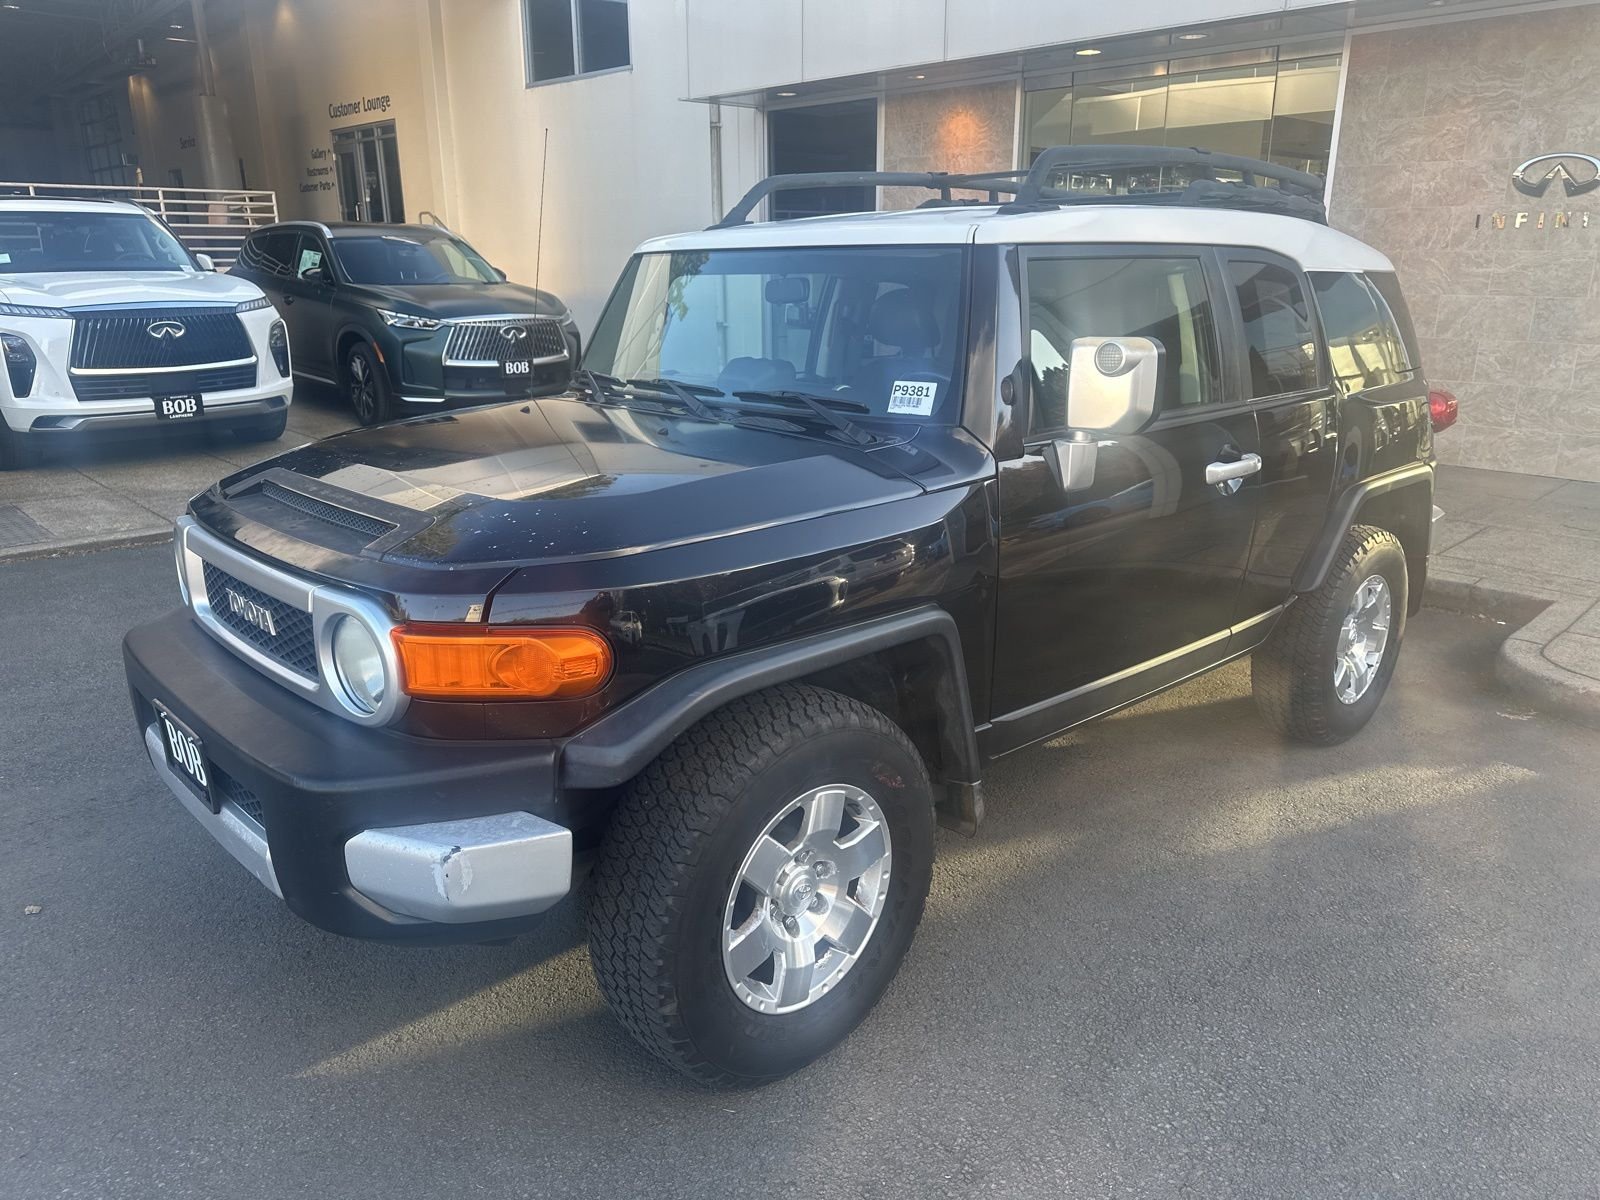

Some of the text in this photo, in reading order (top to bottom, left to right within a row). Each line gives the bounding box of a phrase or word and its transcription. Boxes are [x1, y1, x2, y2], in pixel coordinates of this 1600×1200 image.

[328, 95, 391, 119] Customer Lounge
[299, 181, 331, 193] Customer Parts
[505, 361, 530, 374] BOB
[893, 384, 930, 398] P9381
[162, 398, 197, 415] BOB
[225, 587, 277, 636] TOYOTA
[164, 718, 207, 787] BOB
